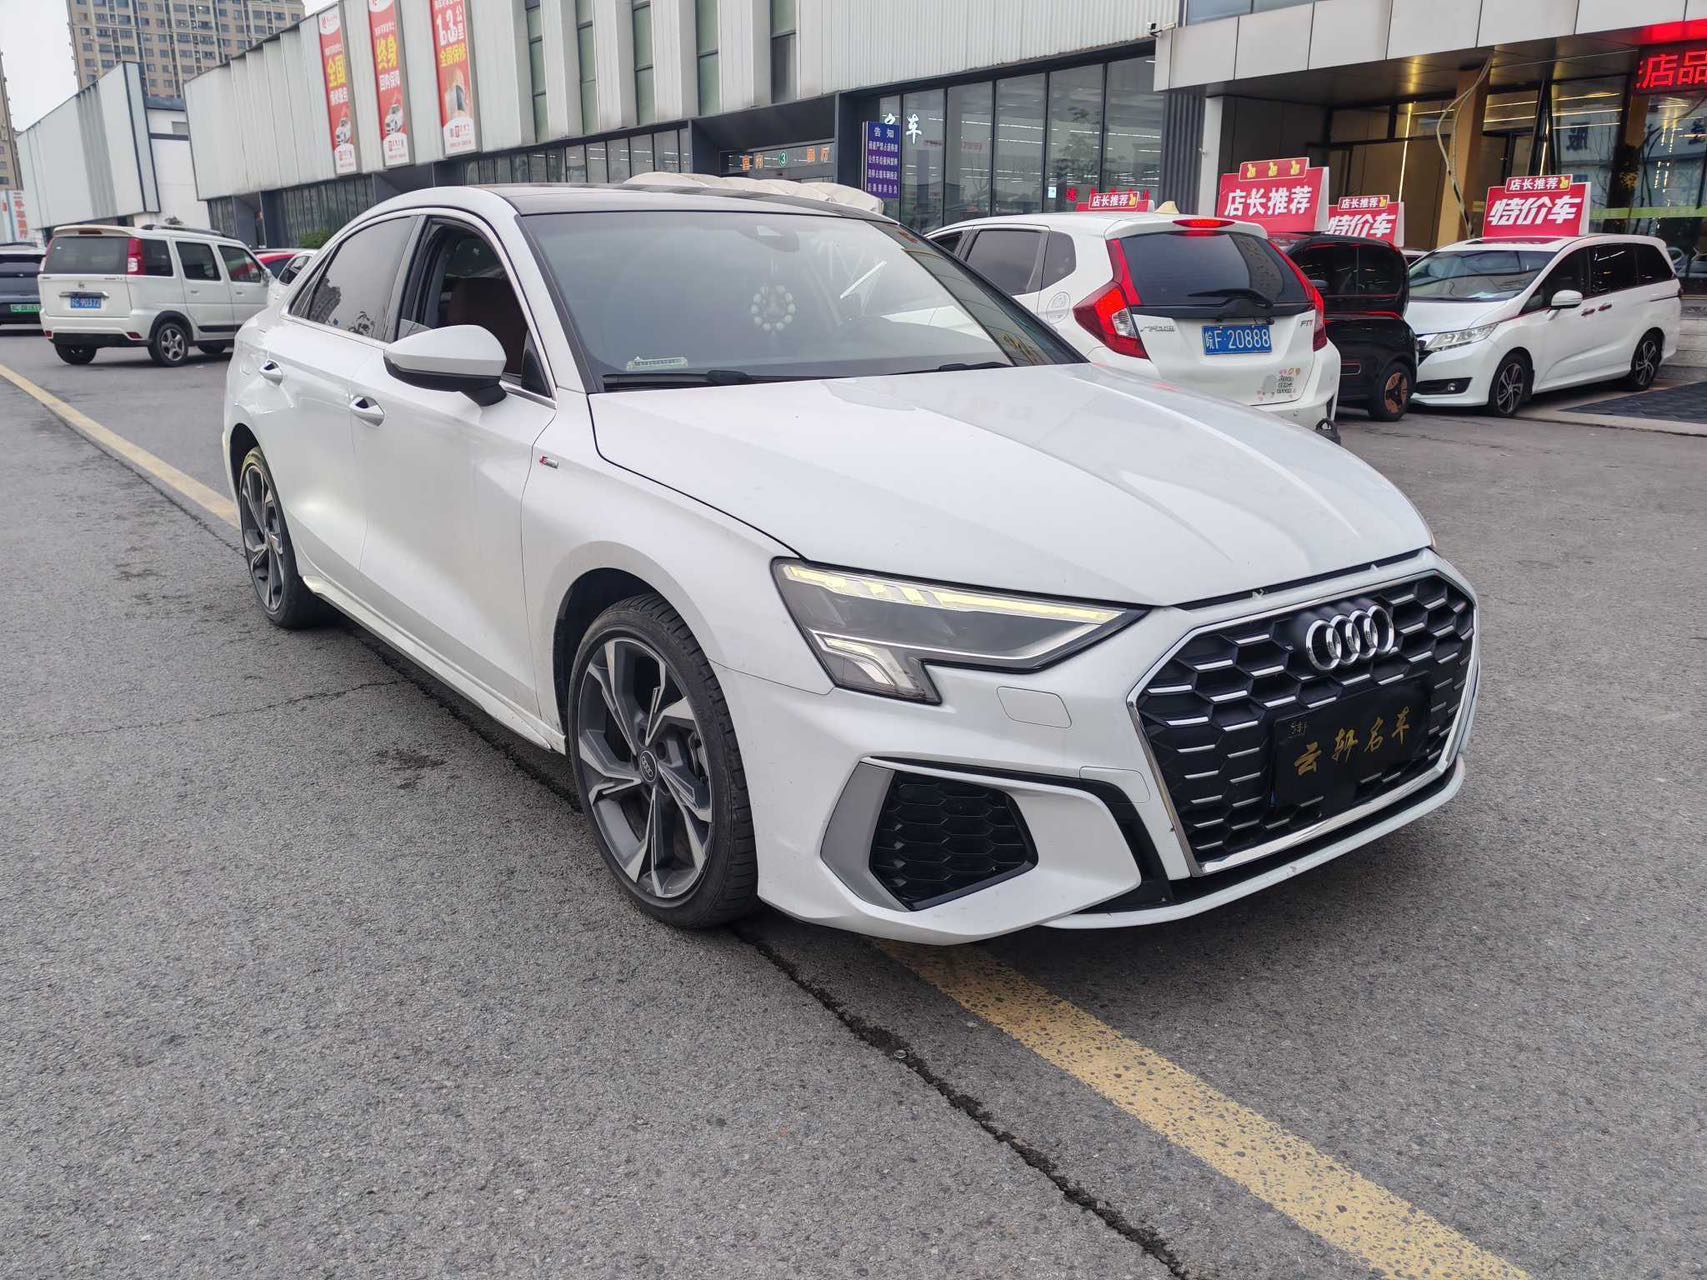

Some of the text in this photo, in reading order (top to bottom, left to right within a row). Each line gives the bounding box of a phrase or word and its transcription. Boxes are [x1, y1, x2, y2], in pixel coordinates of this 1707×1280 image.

[874, 127, 895, 139] 告知
[1510, 177, 1559, 191] 店长推荐
[1091, 194, 1130, 207] 店长推荐
[1224, 185, 1313, 217] 店长推荐
[1340, 197, 1379, 209] 店长推荐
[1487, 195, 1582, 226] 特价车
[1325, 212, 1397, 238] 特价车
